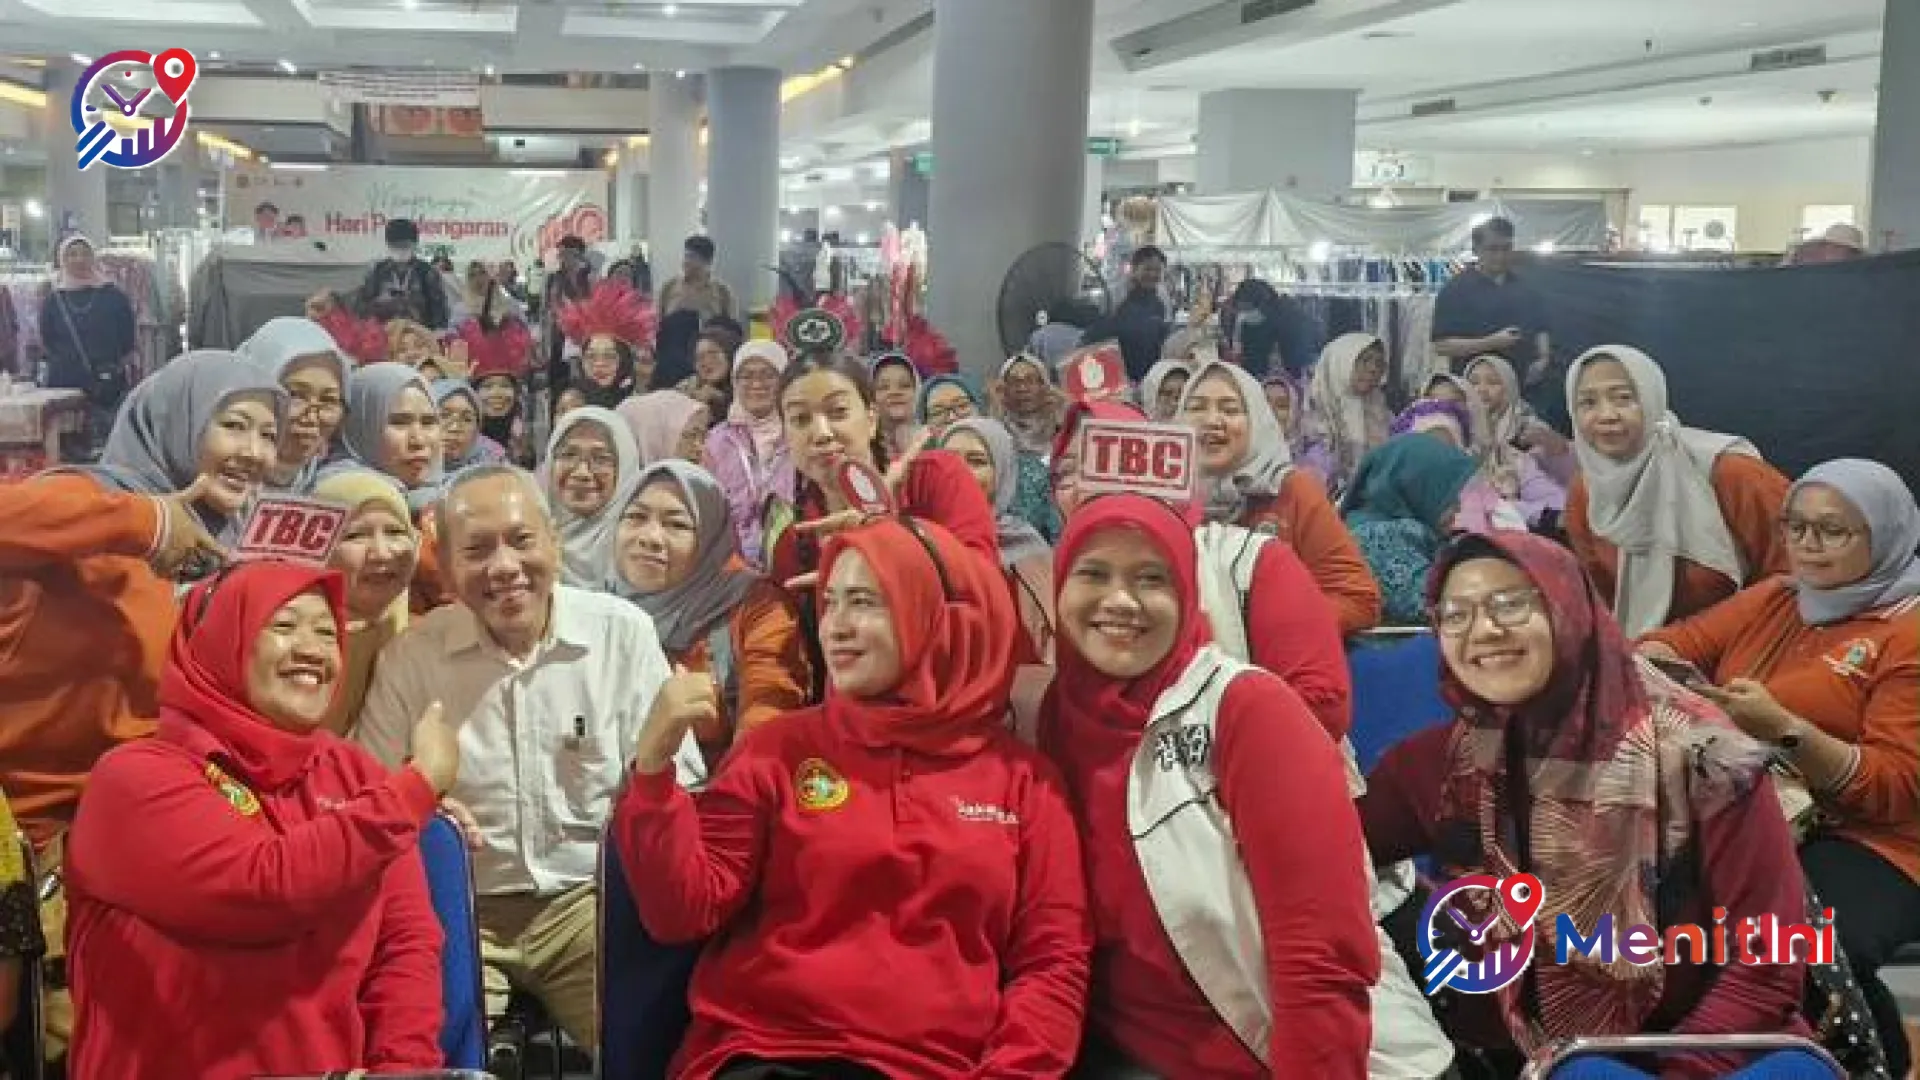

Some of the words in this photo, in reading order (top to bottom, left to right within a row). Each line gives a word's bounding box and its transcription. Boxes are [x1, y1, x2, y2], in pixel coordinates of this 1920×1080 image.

[325, 211, 368, 234] Hari
[371, 209, 508, 240] Pdengaran
[1092, 435, 1183, 480] TBC
[250, 507, 334, 550] TBC
